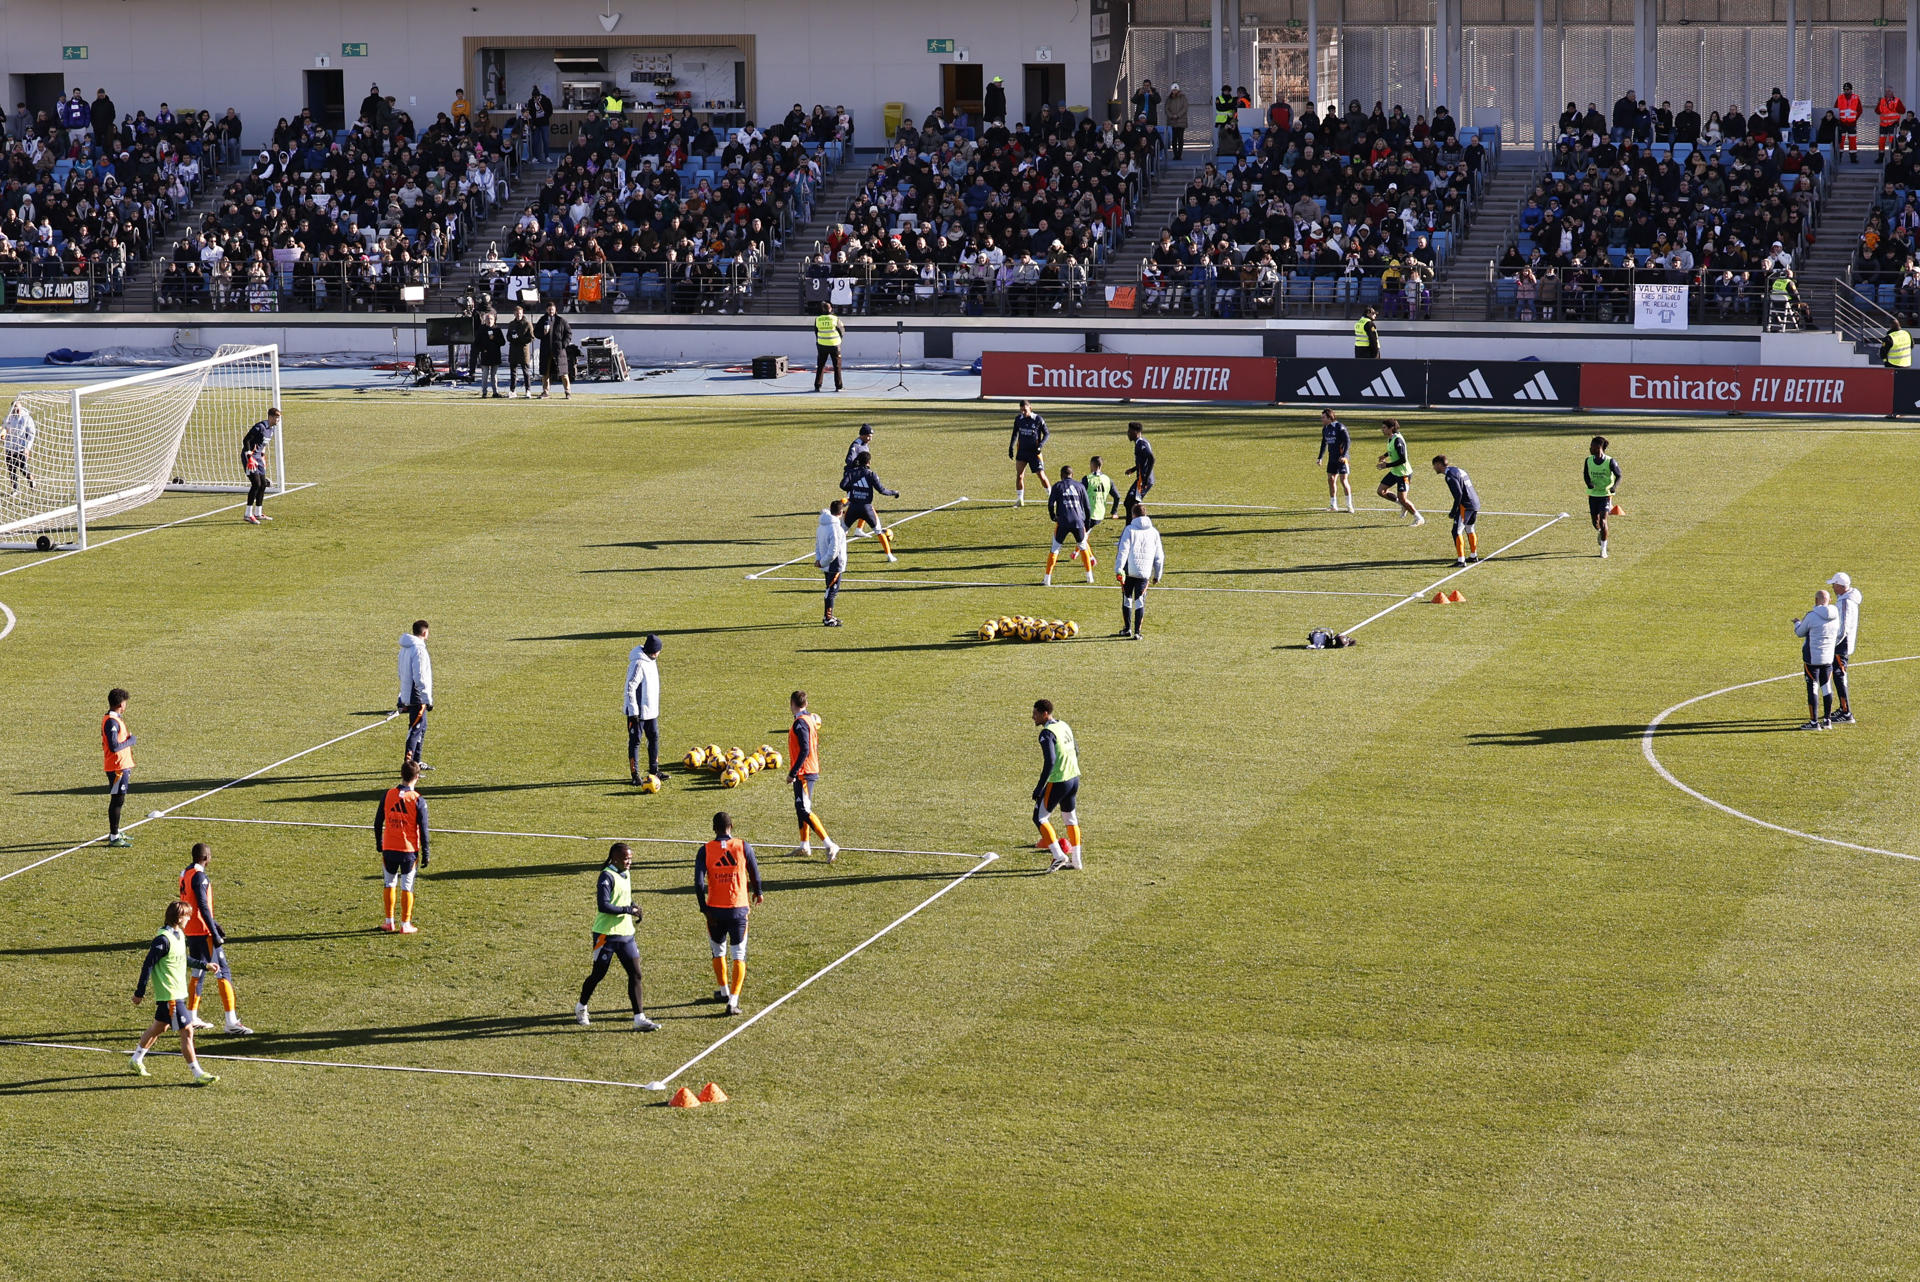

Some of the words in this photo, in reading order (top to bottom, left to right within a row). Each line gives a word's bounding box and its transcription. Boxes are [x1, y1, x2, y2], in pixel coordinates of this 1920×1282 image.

[44, 283, 54, 298] TE
[54, 283, 73, 298] AMO
[812, 278, 820, 290] 9
[838, 279, 845, 291] 9
[1654, 301, 1678, 309] REGALAS
[1026, 363, 1133, 389] Emirates
[1142, 366, 1171, 390] FLY
[1172, 367, 1231, 391] BETTER
[1629, 374, 1742, 401] Emirates
[1751, 377, 1780, 402] FLY
[1783, 379, 1845, 403] BETTER
